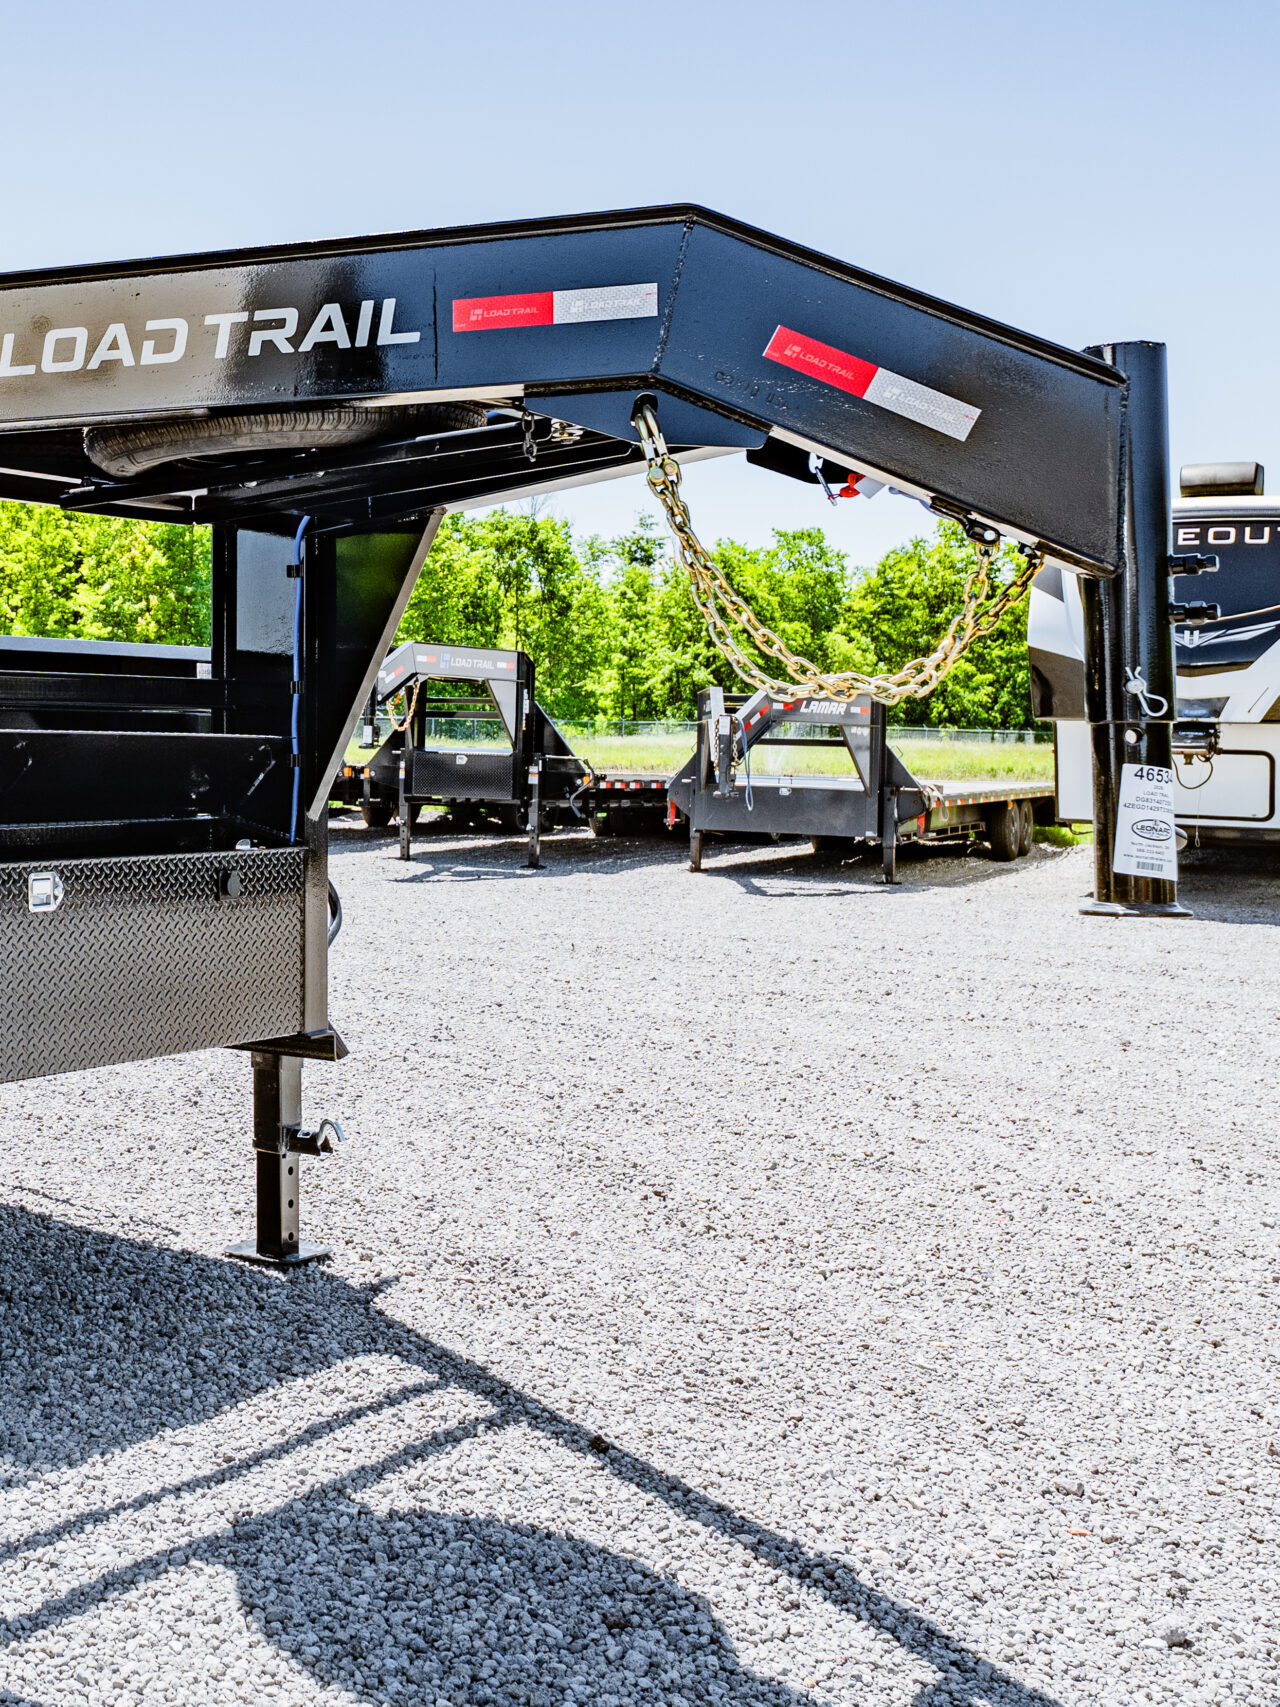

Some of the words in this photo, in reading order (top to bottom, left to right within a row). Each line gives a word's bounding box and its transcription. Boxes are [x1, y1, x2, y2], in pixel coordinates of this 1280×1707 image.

[484, 308, 510, 318] LOAD
[511, 306, 539, 316] TRAIL
[204, 297, 421, 360] TRAIL
[799, 351, 827, 368] LOAD
[827, 363, 855, 380] TRAIL
[1177, 526, 1280, 546] EOU
[450, 656, 471, 668] LOAD
[472, 658, 495, 670] TRAIL
[800, 700, 848, 715] LAMAR
